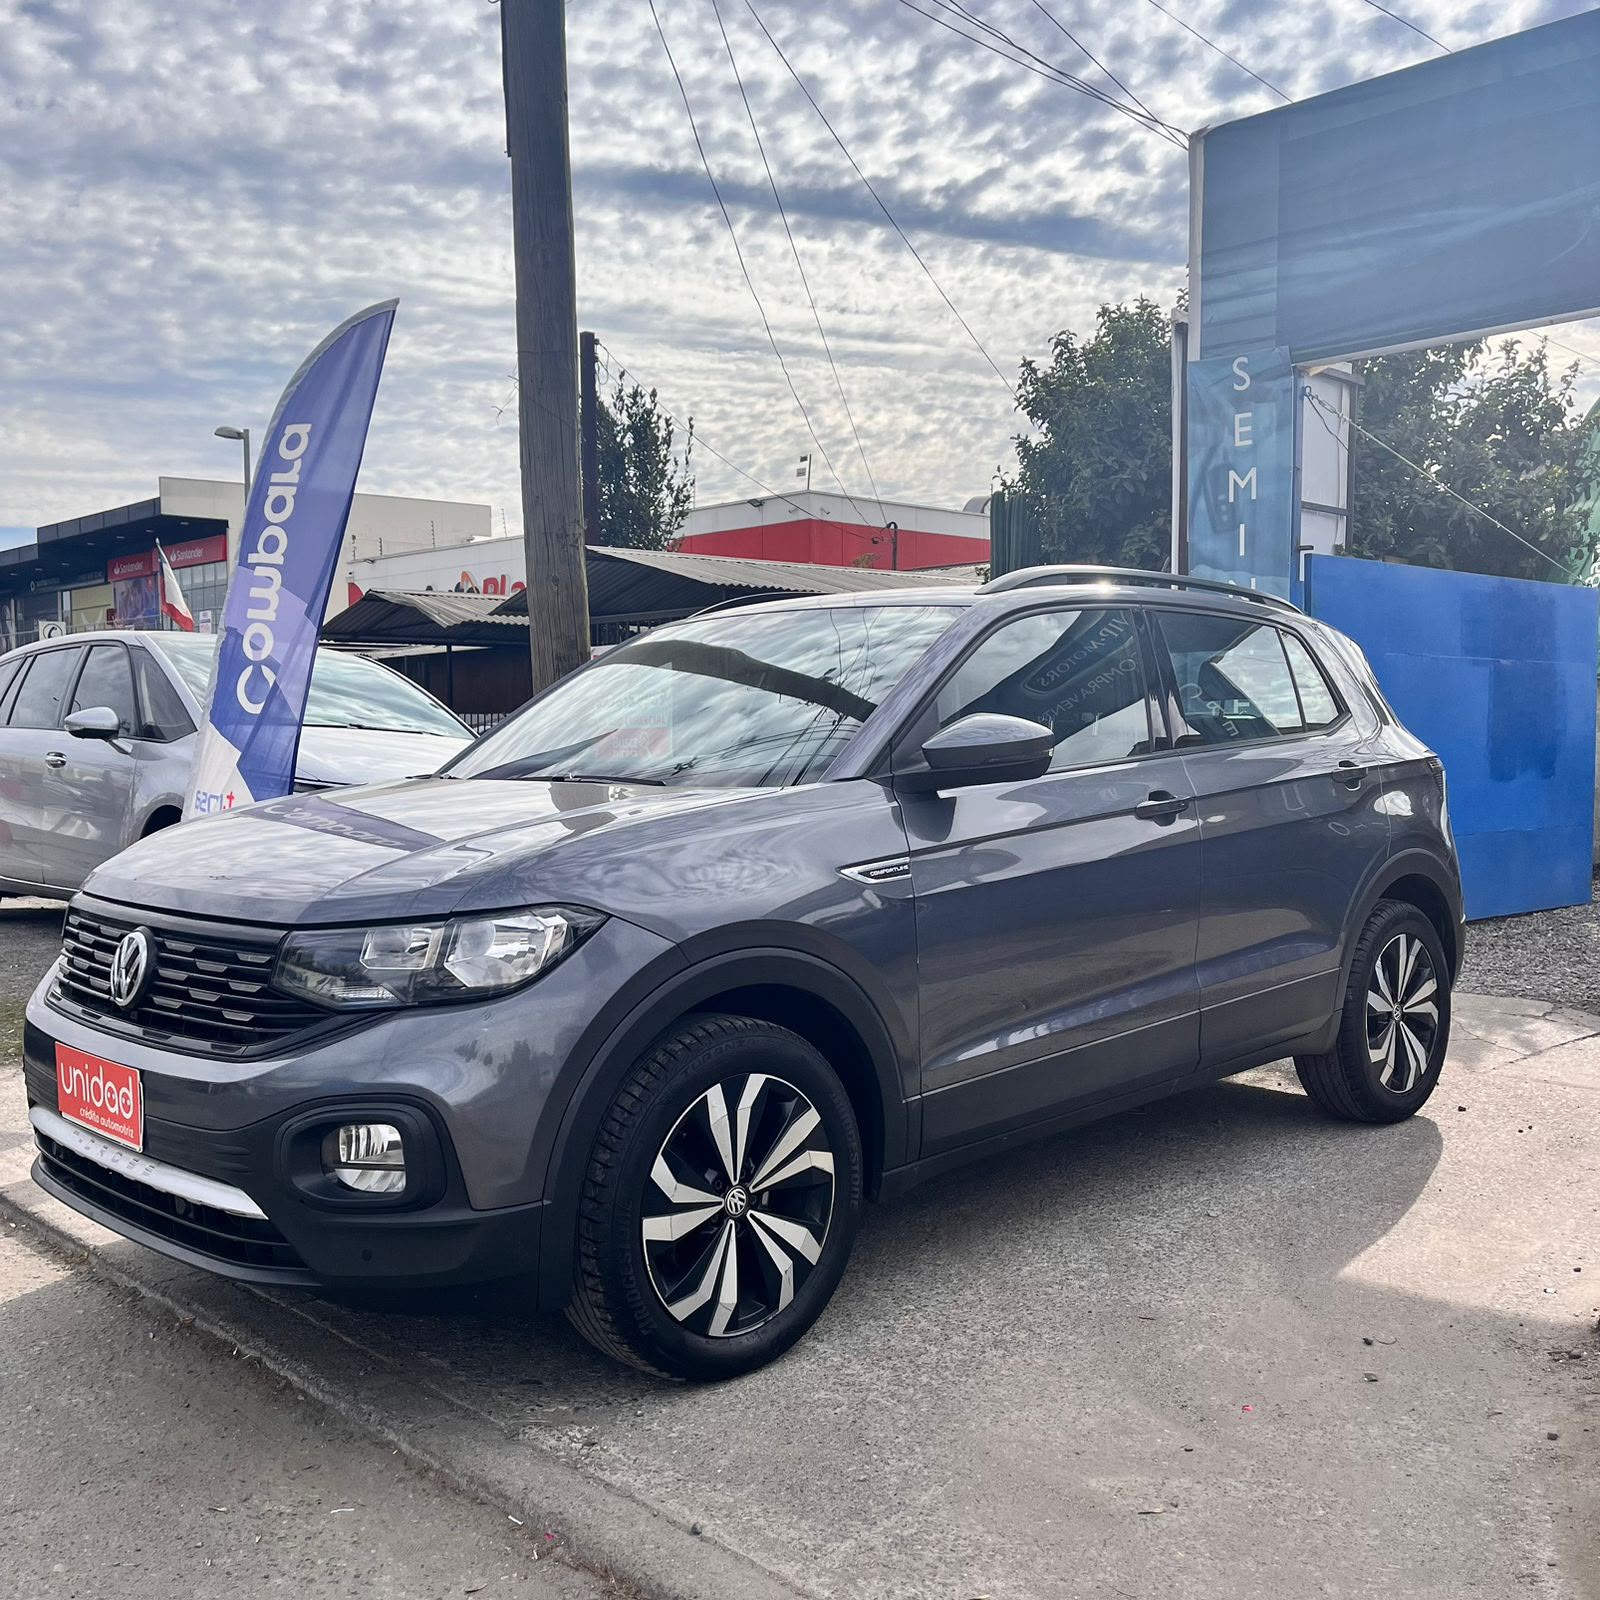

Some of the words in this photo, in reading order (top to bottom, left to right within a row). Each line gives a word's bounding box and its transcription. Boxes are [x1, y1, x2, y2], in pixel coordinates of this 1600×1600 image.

[177, 547, 204, 561] Santander
[119, 560, 145, 575] Santander
[61, 1061, 134, 1119] unidad
[100, 1116, 135, 1139] automotriz
